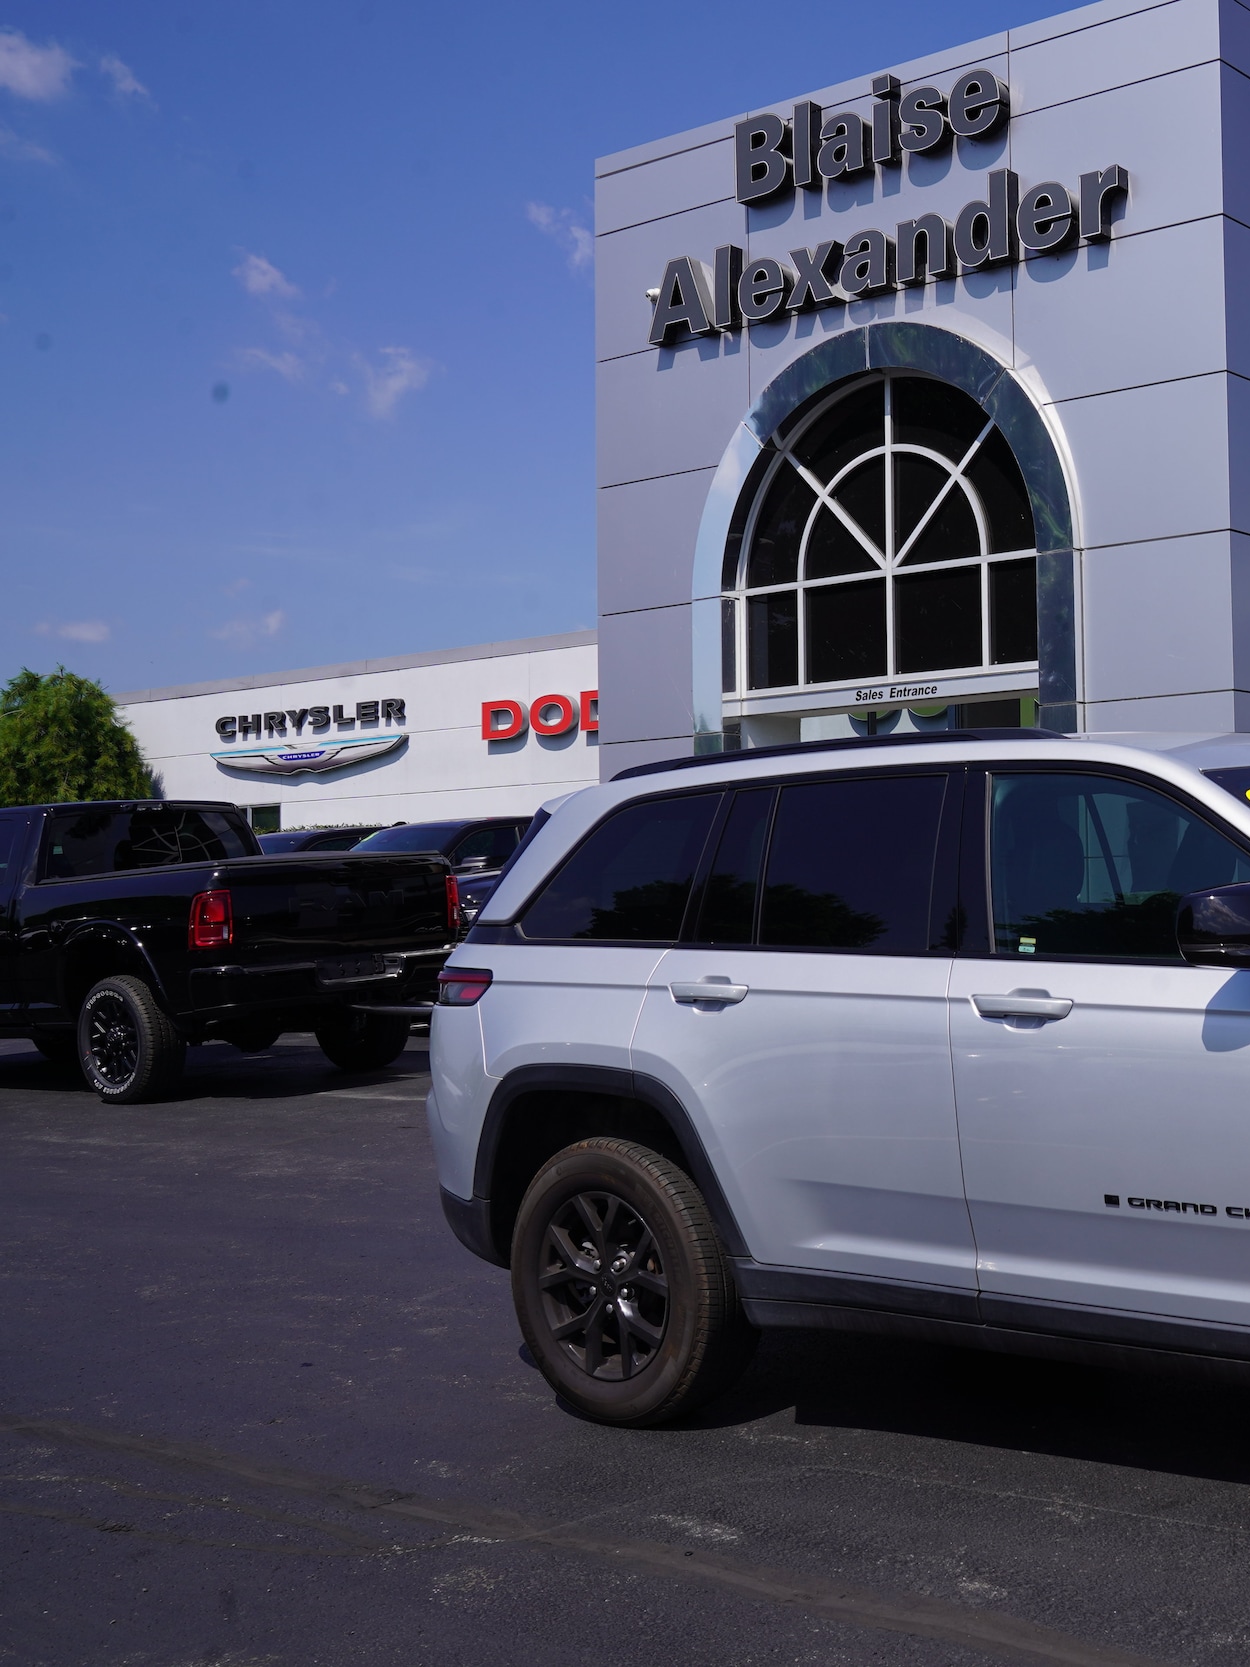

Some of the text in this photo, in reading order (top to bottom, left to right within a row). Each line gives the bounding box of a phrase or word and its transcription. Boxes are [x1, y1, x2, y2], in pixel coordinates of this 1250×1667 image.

[735, 68, 1009, 206] Blaise
[648, 164, 1128, 347] Alexander
[855, 685, 938, 701] Sales Entrance
[215, 698, 406, 737] CHRYSLER
[282, 752, 321, 760] CHRYSLER
[1127, 1197, 1218, 1216] GRAND
